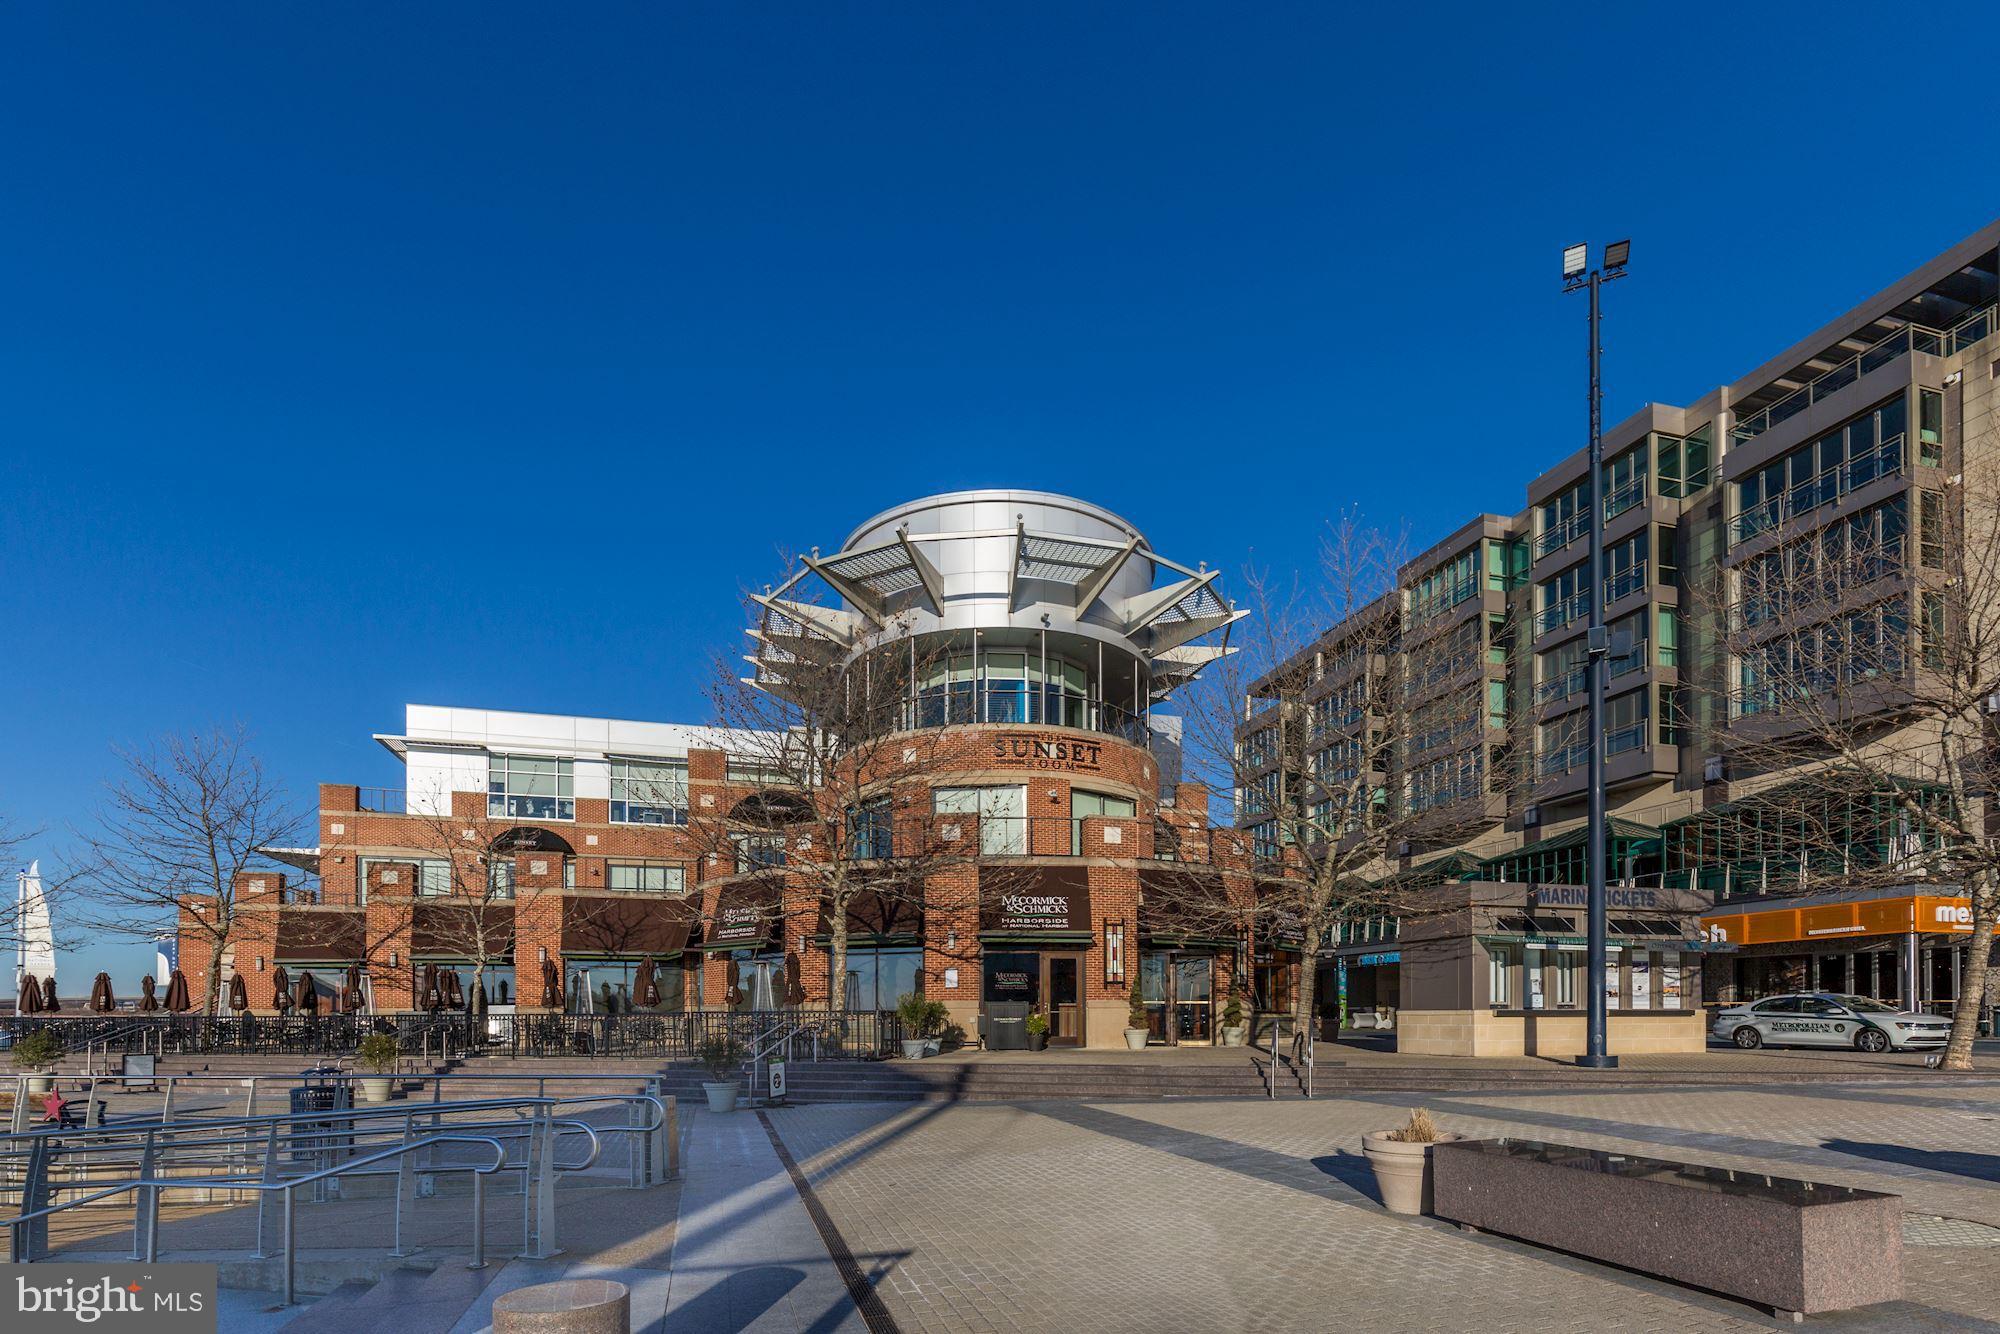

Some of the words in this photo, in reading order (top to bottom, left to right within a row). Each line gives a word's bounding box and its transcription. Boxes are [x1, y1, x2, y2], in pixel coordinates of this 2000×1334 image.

[992, 739, 1102, 764] SUNSET
[1539, 888, 1588, 905] MARIN
[1605, 890, 1656, 907] ICKETS
[1771, 1022, 1830, 1030] METROPOLITAN
